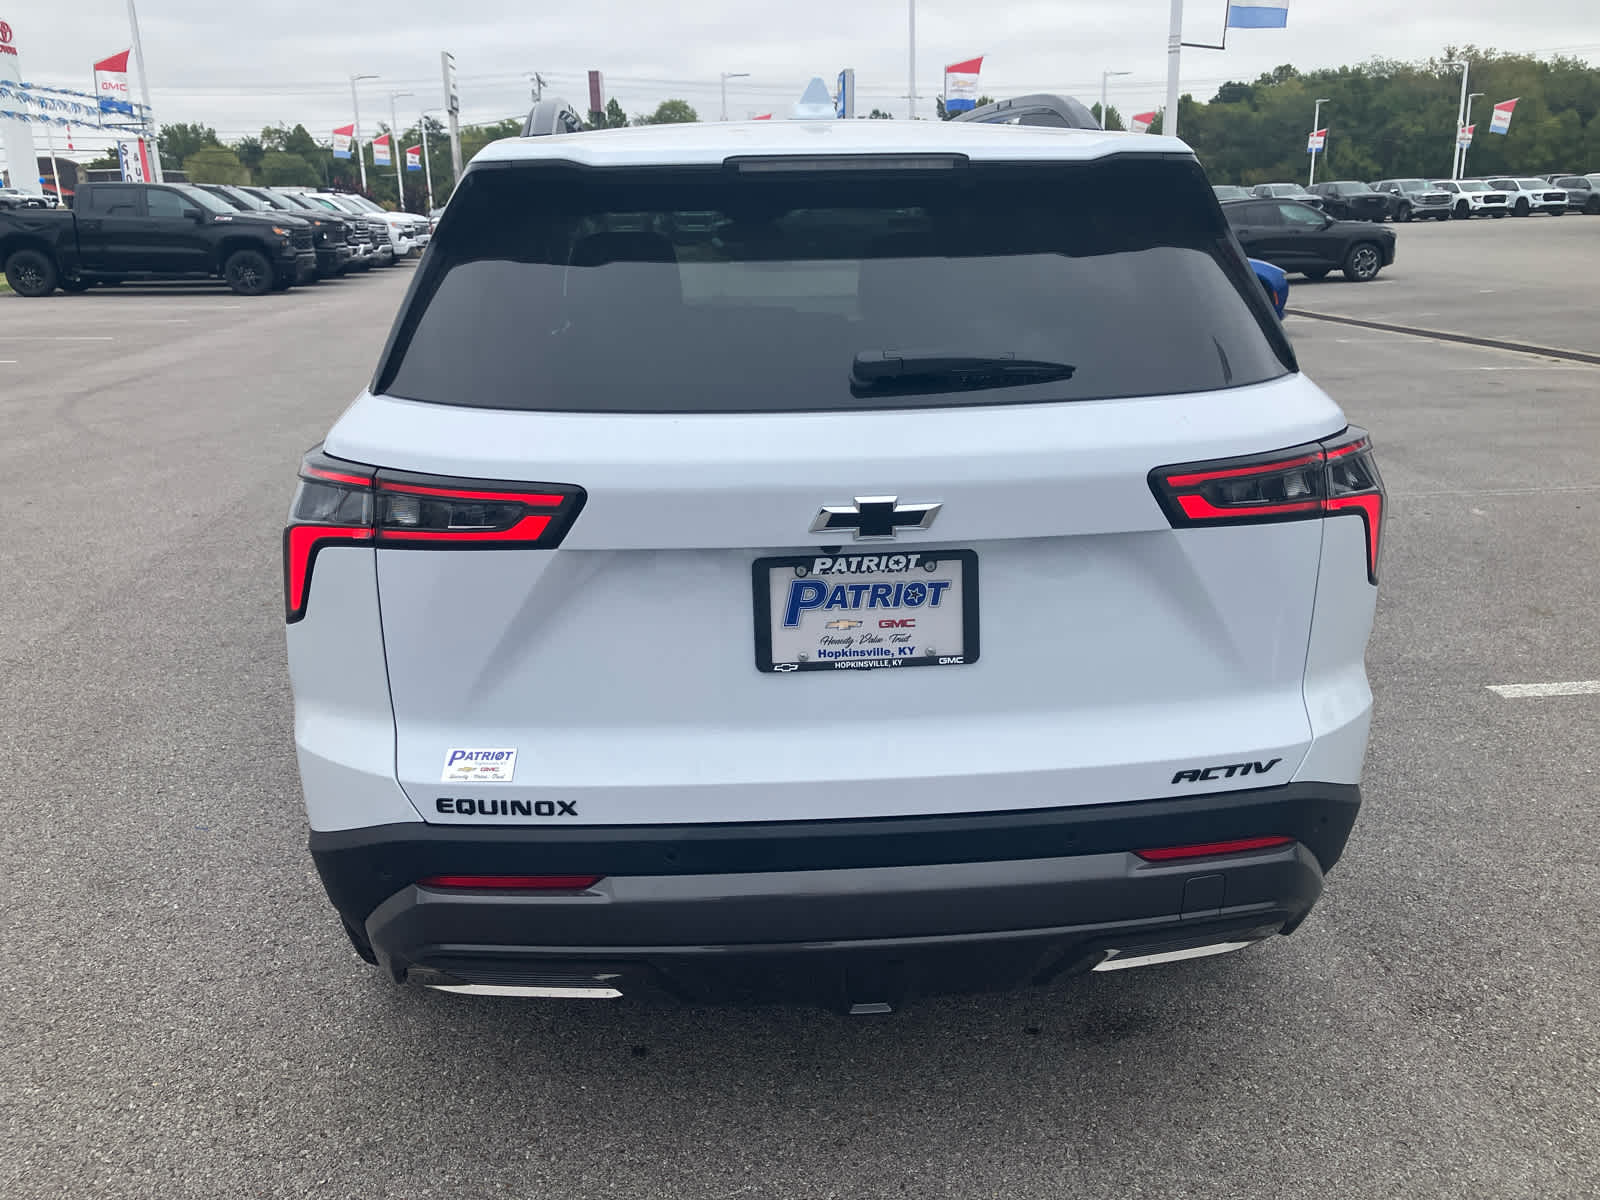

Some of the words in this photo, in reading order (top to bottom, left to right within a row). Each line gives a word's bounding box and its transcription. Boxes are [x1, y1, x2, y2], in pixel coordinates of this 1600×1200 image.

[101, 81, 128, 92] GMC
[812, 554, 921, 575] PATRIOT
[783, 578, 952, 628] PATRIOT
[878, 618, 916, 629] GMC
[818, 648, 895, 660] Hopkinsville,
[898, 646, 916, 656] KY
[834, 660, 891, 669] HOPKINSVILLE,
[892, 659, 903, 667] KY
[938, 657, 964, 665] GMC
[448, 750, 514, 766] PATRIOT
[1171, 758, 1282, 784] ACTIV
[436, 798, 579, 816] EQUINOX
